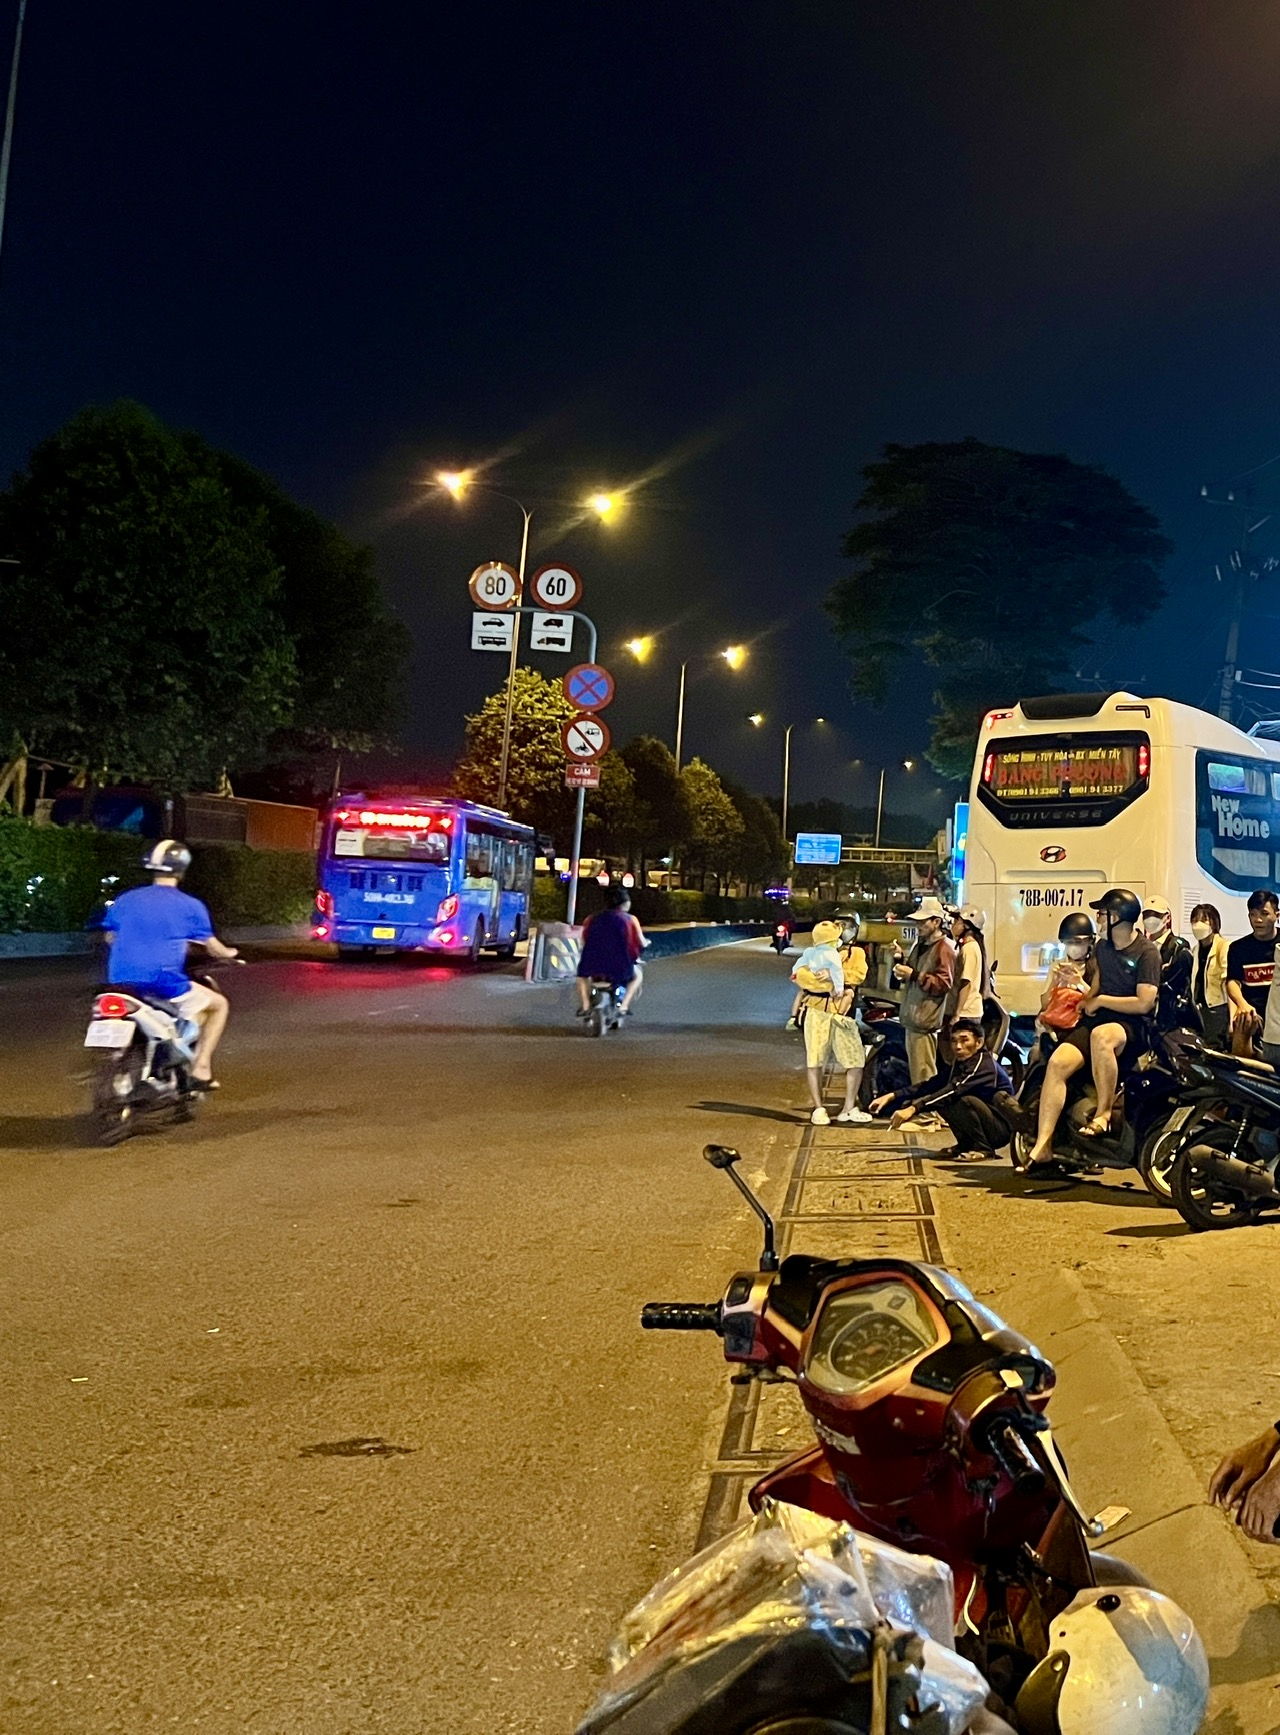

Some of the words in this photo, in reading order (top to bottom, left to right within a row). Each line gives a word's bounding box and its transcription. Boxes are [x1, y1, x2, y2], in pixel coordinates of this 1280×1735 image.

[485, 577, 507, 596] 80
[546, 577, 567, 597] 60
[1211, 794, 1240, 813] New
[1218, 811, 1270, 840] Home
[1019, 888, 1084, 907] 78B-007.17
